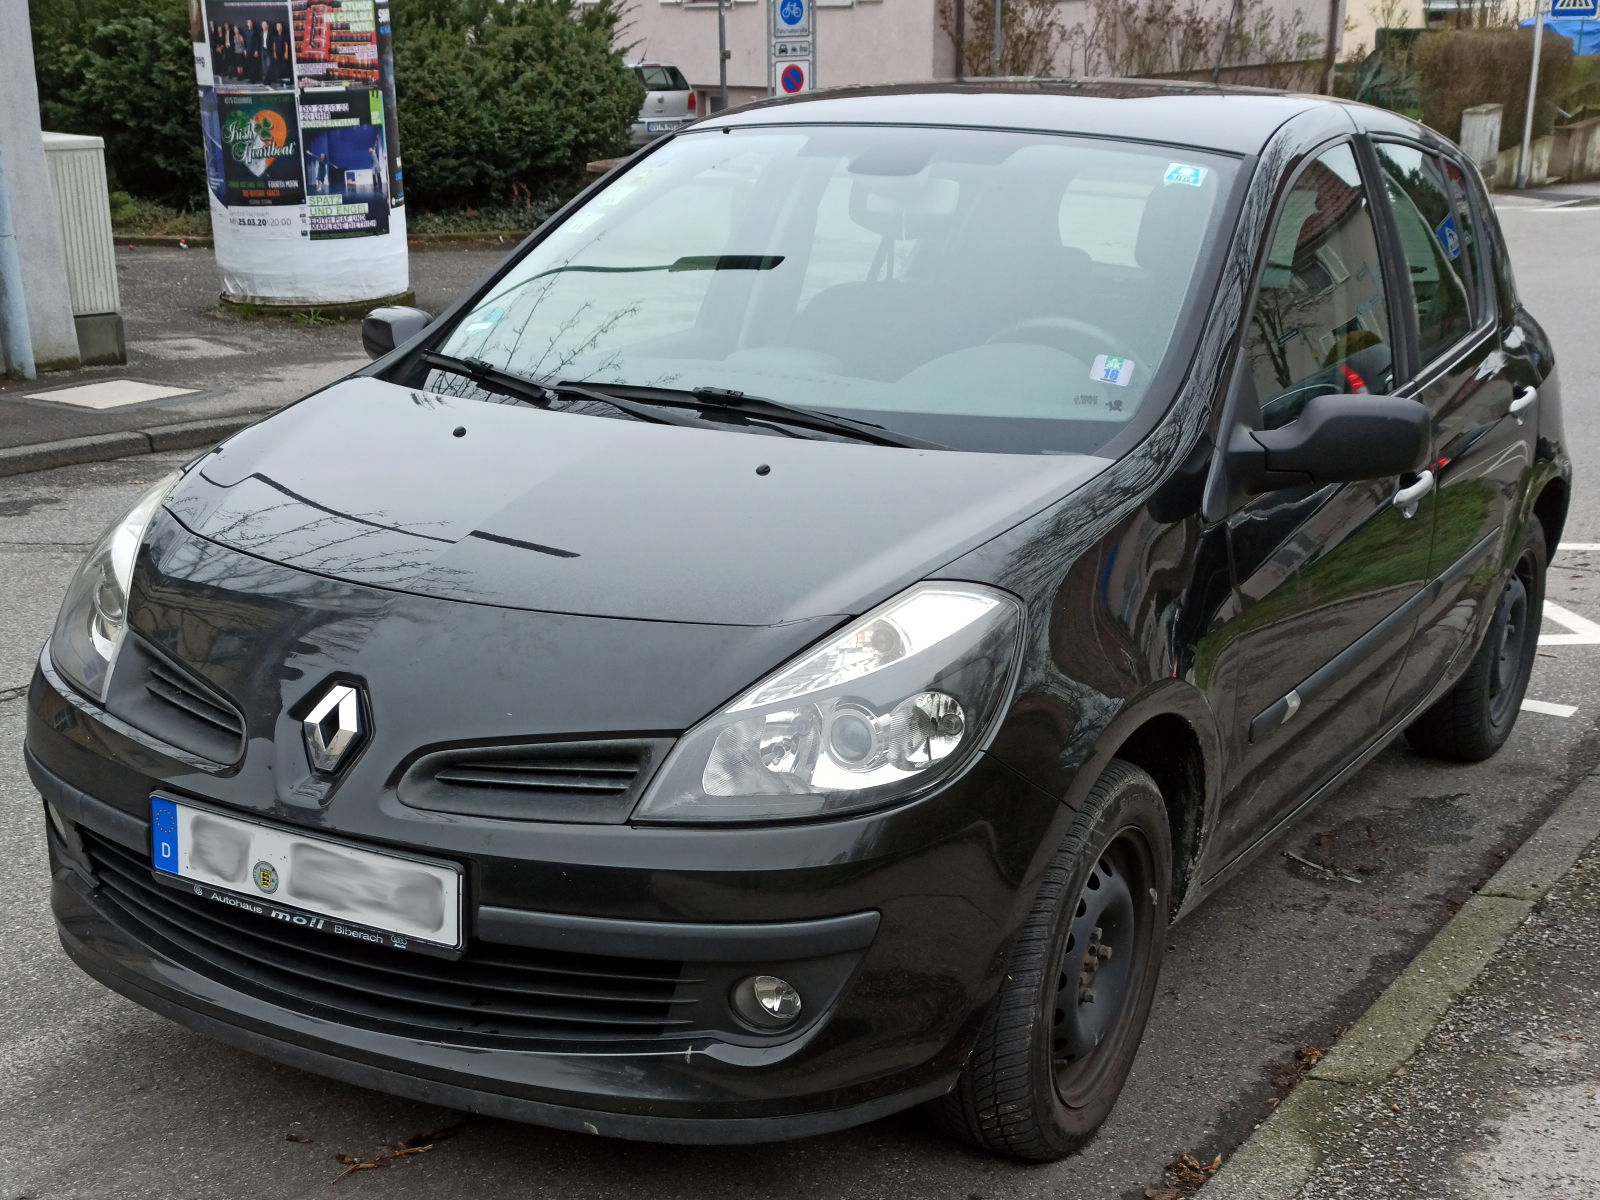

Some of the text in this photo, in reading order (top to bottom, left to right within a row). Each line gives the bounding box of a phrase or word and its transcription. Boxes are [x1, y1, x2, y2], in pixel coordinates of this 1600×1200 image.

[341, 1, 372, 11] STUNDE
[324, 13, 335, 23] IM
[337, 11, 374, 22] CHELSEA
[350, 22, 374, 32] HOTEL
[222, 120, 254, 143] Irish
[232, 141, 296, 164] Heartbeat
[286, 180, 298, 188] MOON
[309, 196, 342, 205] SPATZ
[310, 204, 369, 216] UND ENGEL
[1104, 369, 1119, 380] 16
[162, 842, 171, 858] D
[211, 893, 383, 943] Autohaus moll Biberach
